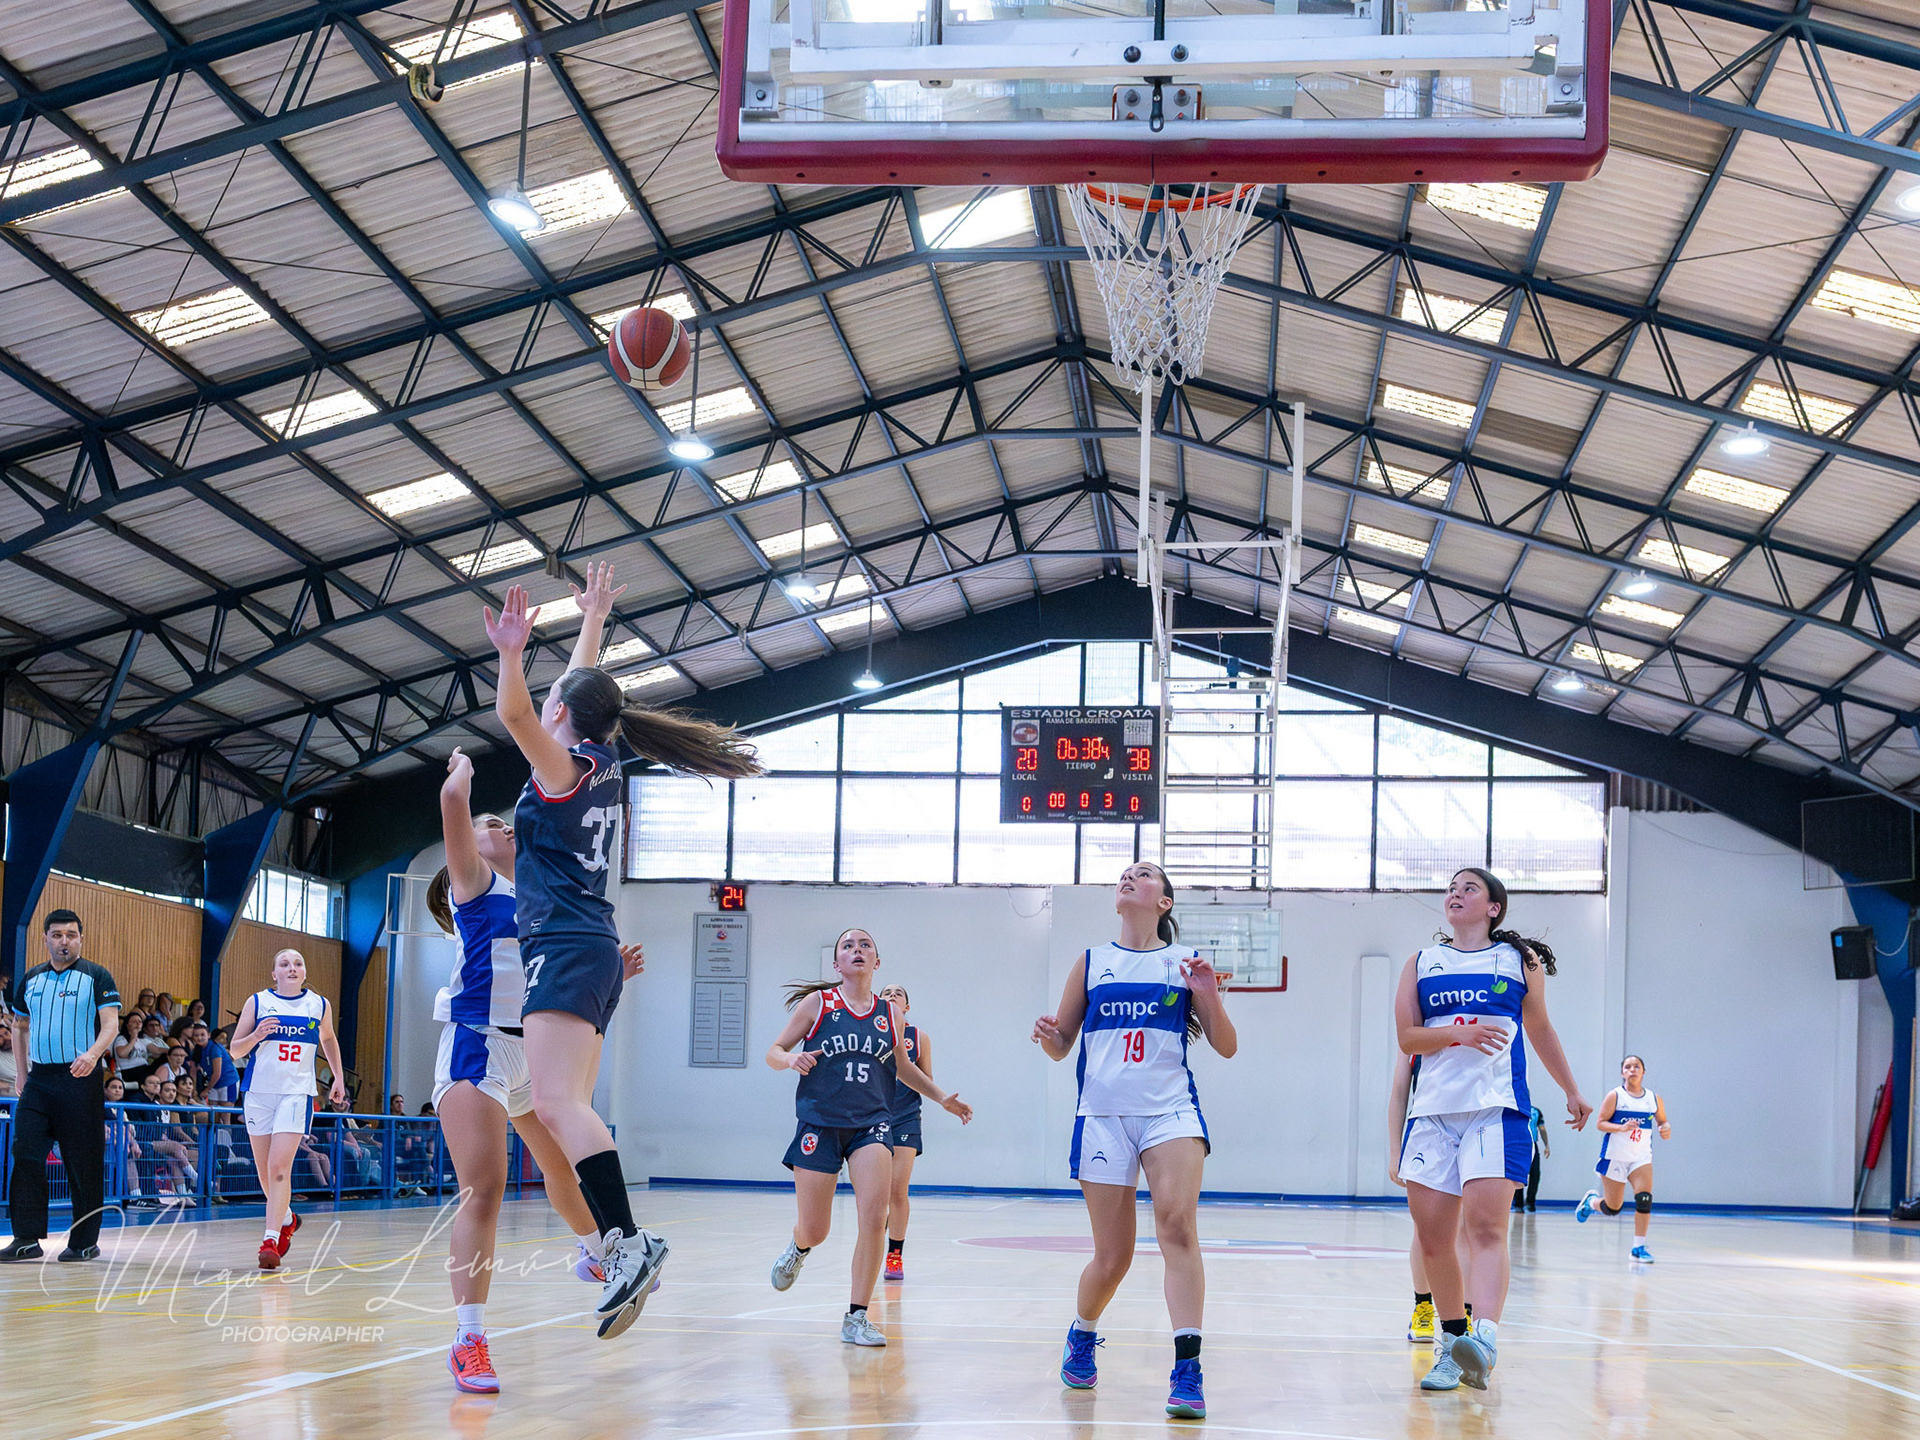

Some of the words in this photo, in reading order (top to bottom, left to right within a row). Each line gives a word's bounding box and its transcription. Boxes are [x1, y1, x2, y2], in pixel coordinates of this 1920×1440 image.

[1010, 709, 1081, 718] ESTADIO
[1086, 709, 1154, 718] CROATA
[1016, 748, 1038, 771] 20
[1065, 762, 1096, 770] TIEMPO
[1130, 748, 1150, 771] 38
[1022, 797, 1032, 812] 0
[1080, 793, 1090, 808] 0
[1104, 793, 1113, 808] 3
[1130, 797, 1139, 812] 0
[723, 886, 743, 908] 24
[1429, 988, 1488, 1006] cmpc
[1100, 1001, 1159, 1020] cmpc
[274, 1025, 306, 1037] mpc
[278, 1044, 302, 1062] 52
[820, 1033, 893, 1065] CROATA
[1122, 1030, 1145, 1063] 19
[845, 1062, 870, 1084] 15
